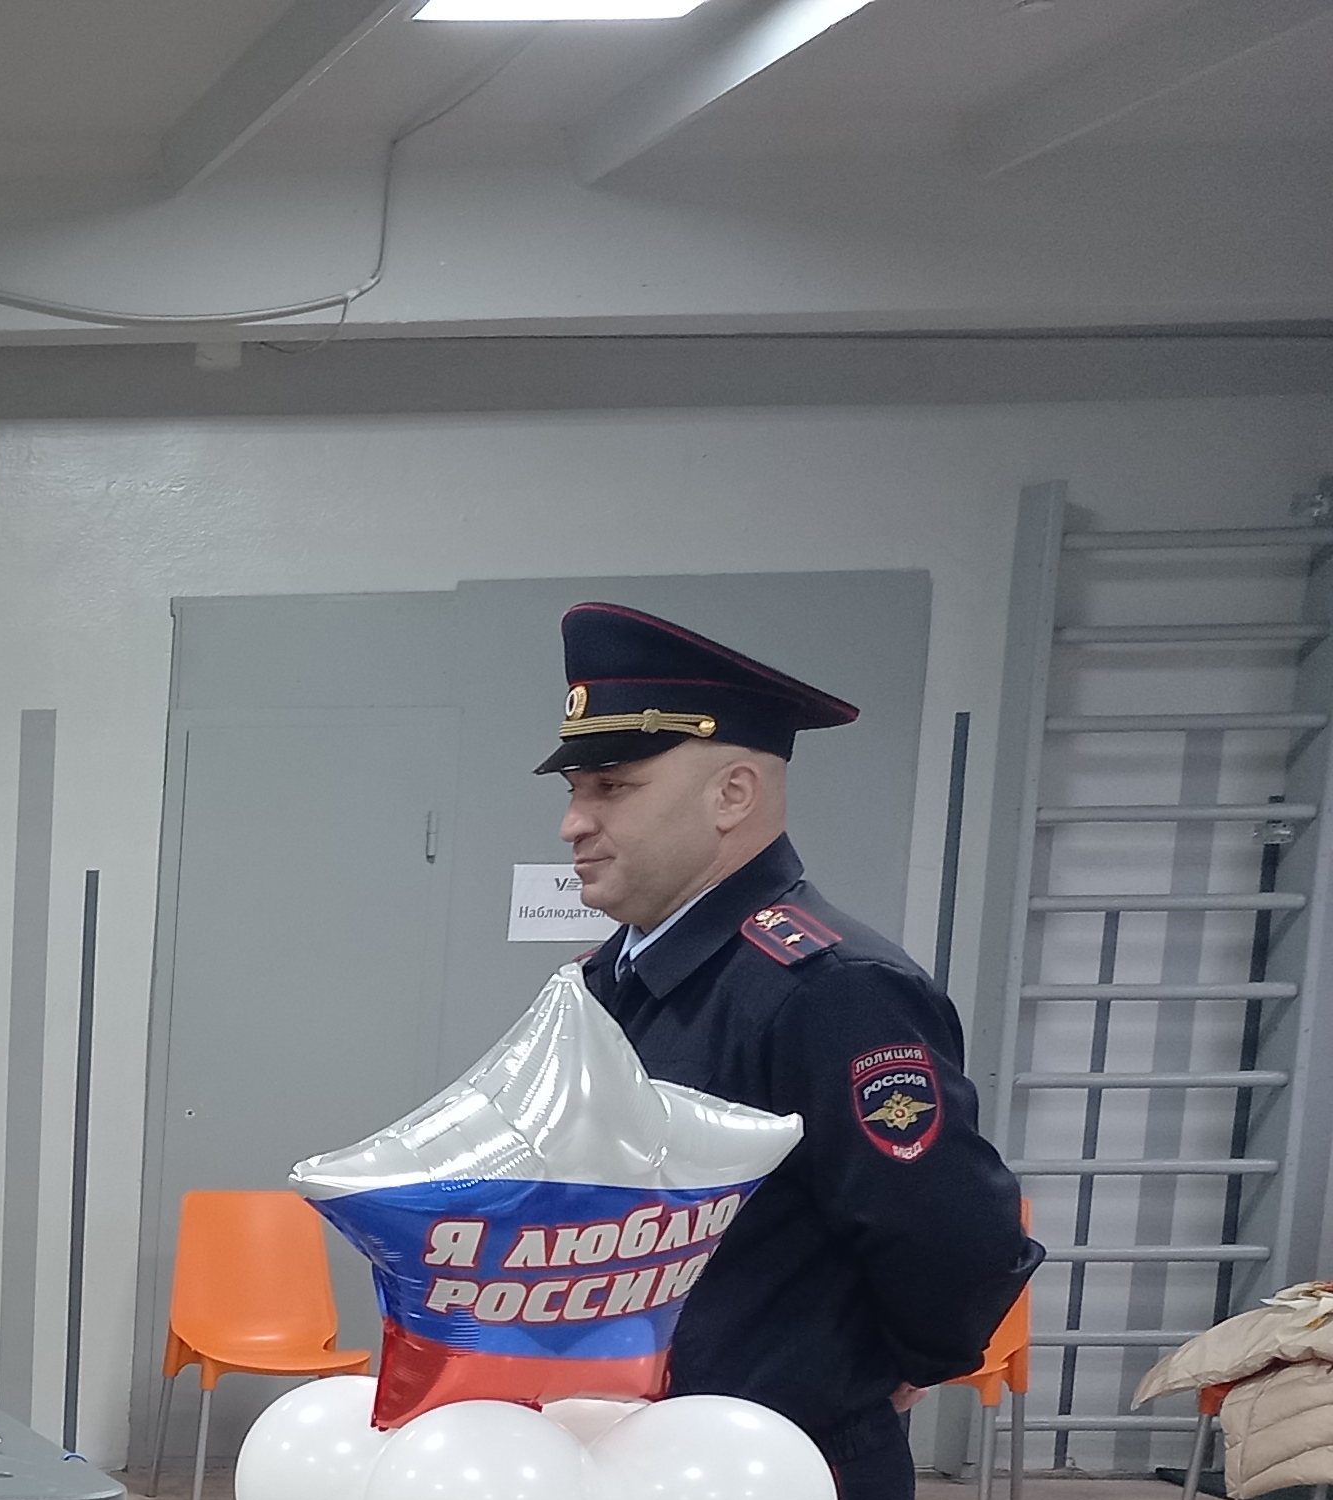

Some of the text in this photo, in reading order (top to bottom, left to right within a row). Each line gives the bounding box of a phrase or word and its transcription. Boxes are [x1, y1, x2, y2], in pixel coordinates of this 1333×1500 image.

[518, 906, 607, 920] Наблюдател
[855, 1049, 923, 1074] ПОЛИЦИЯ
[863, 1073, 927, 1100] РОССИЯ
[424, 1221, 485, 1267] Я
